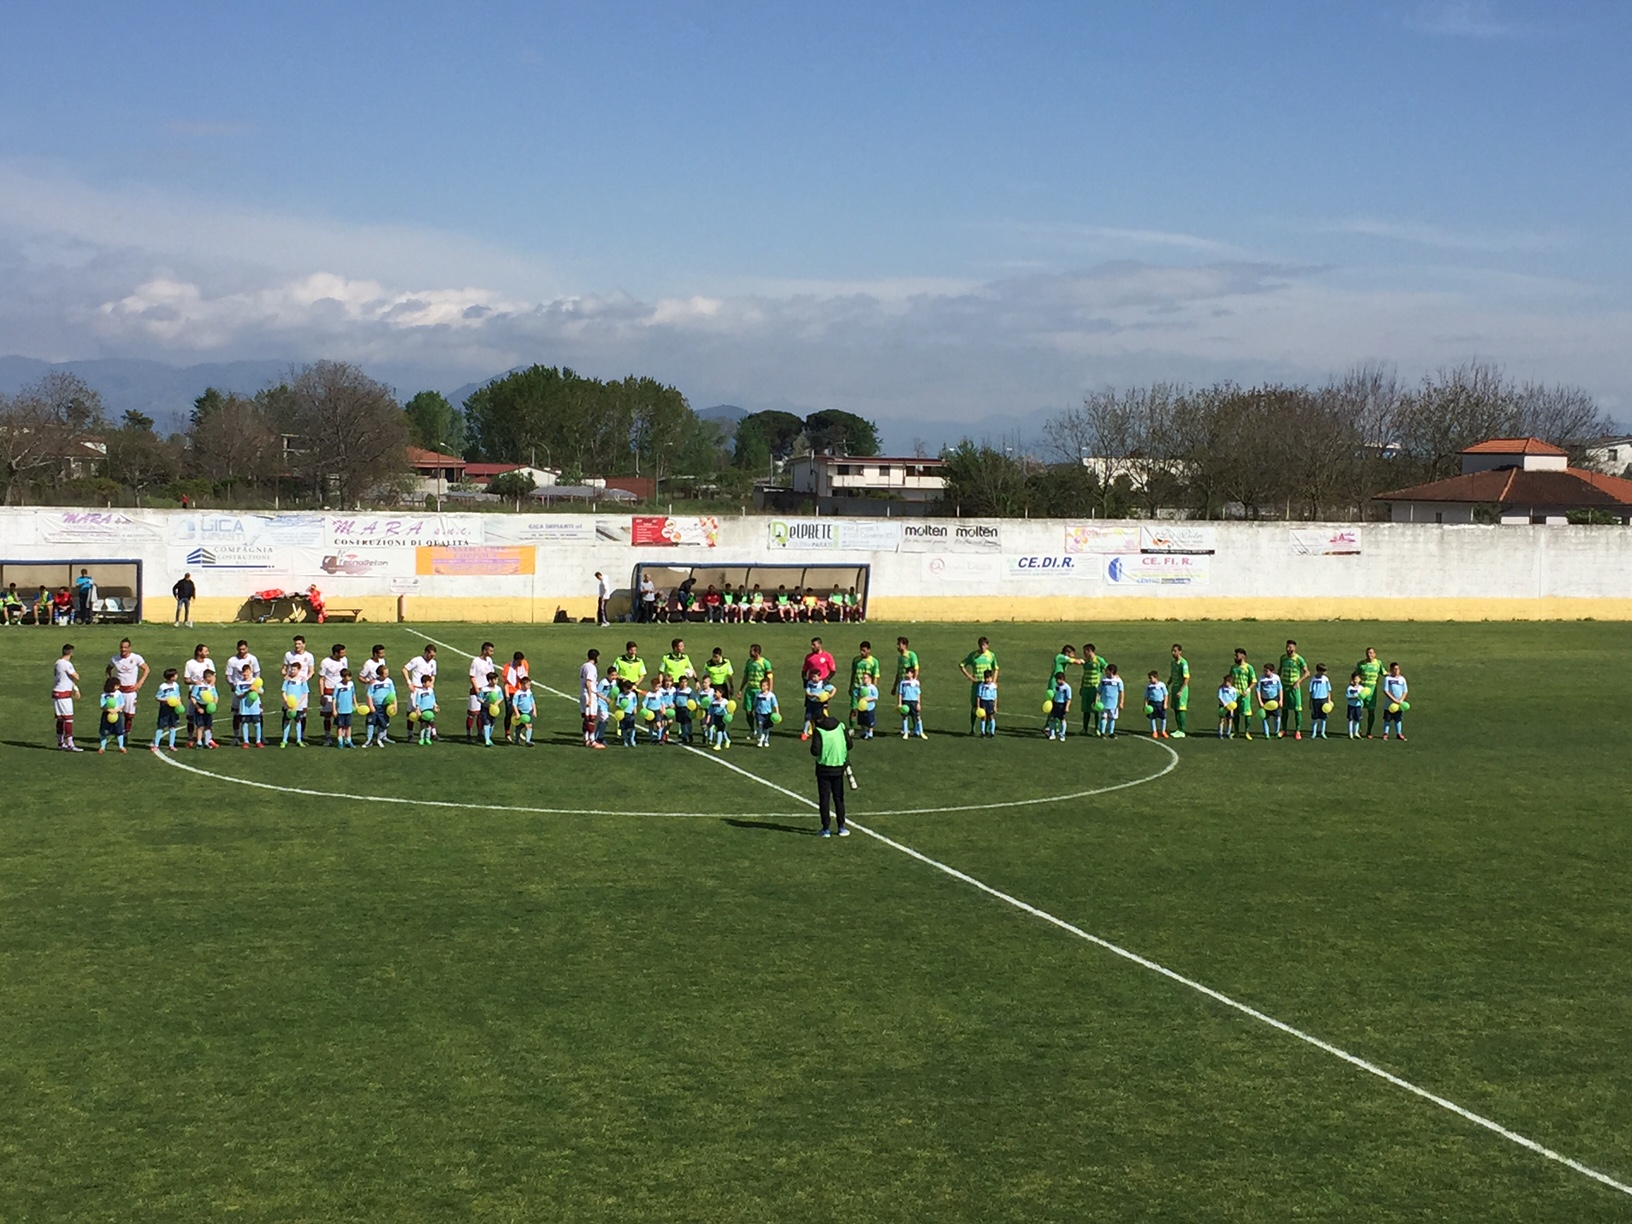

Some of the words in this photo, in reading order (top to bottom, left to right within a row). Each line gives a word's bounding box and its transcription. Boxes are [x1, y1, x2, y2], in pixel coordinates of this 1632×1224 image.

[62, 512, 112, 525] MARA
[904, 525, 948, 537] molten
[955, 525, 998, 538] molten
[334, 538, 406, 546] COSTRUZIONI
[410, 538, 422, 546] DI
[1018, 556, 1075, 568] CE.DI.R.
